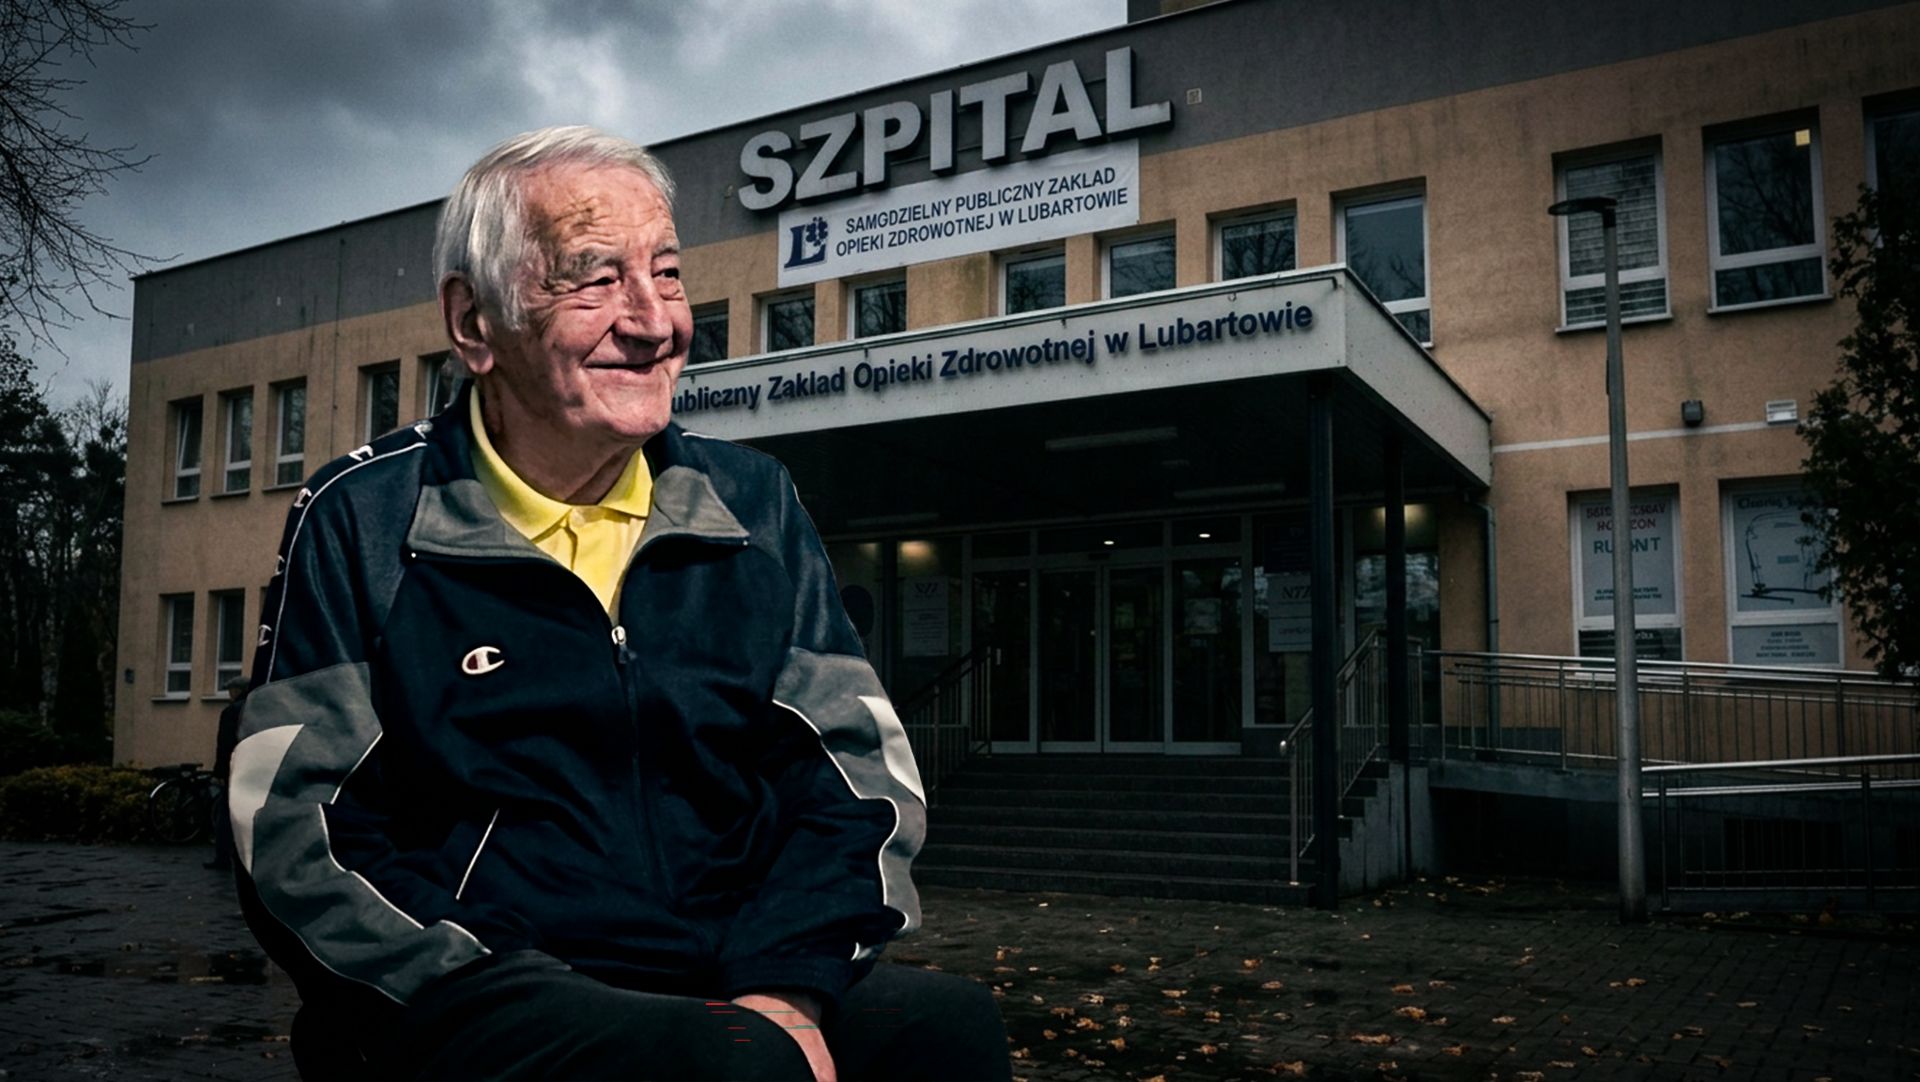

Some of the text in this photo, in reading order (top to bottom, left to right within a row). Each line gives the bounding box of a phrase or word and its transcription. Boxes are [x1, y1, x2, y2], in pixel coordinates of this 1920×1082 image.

[738, 46, 1172, 211] SZPITAL
[836, 187, 1128, 257] OPIEKI ZDROWOTNEJ W LUBARTOWIE
[955, 180, 1044, 213] PUBLICZNY
[1047, 167, 1115, 195] ZAKLAD
[672, 384, 761, 414] ubliczny
[854, 354, 932, 392] Opieki
[940, 330, 1095, 377] Zdrowotnej
[1105, 331, 1129, 353] w
[1139, 301, 1313, 350] Lubartowie
